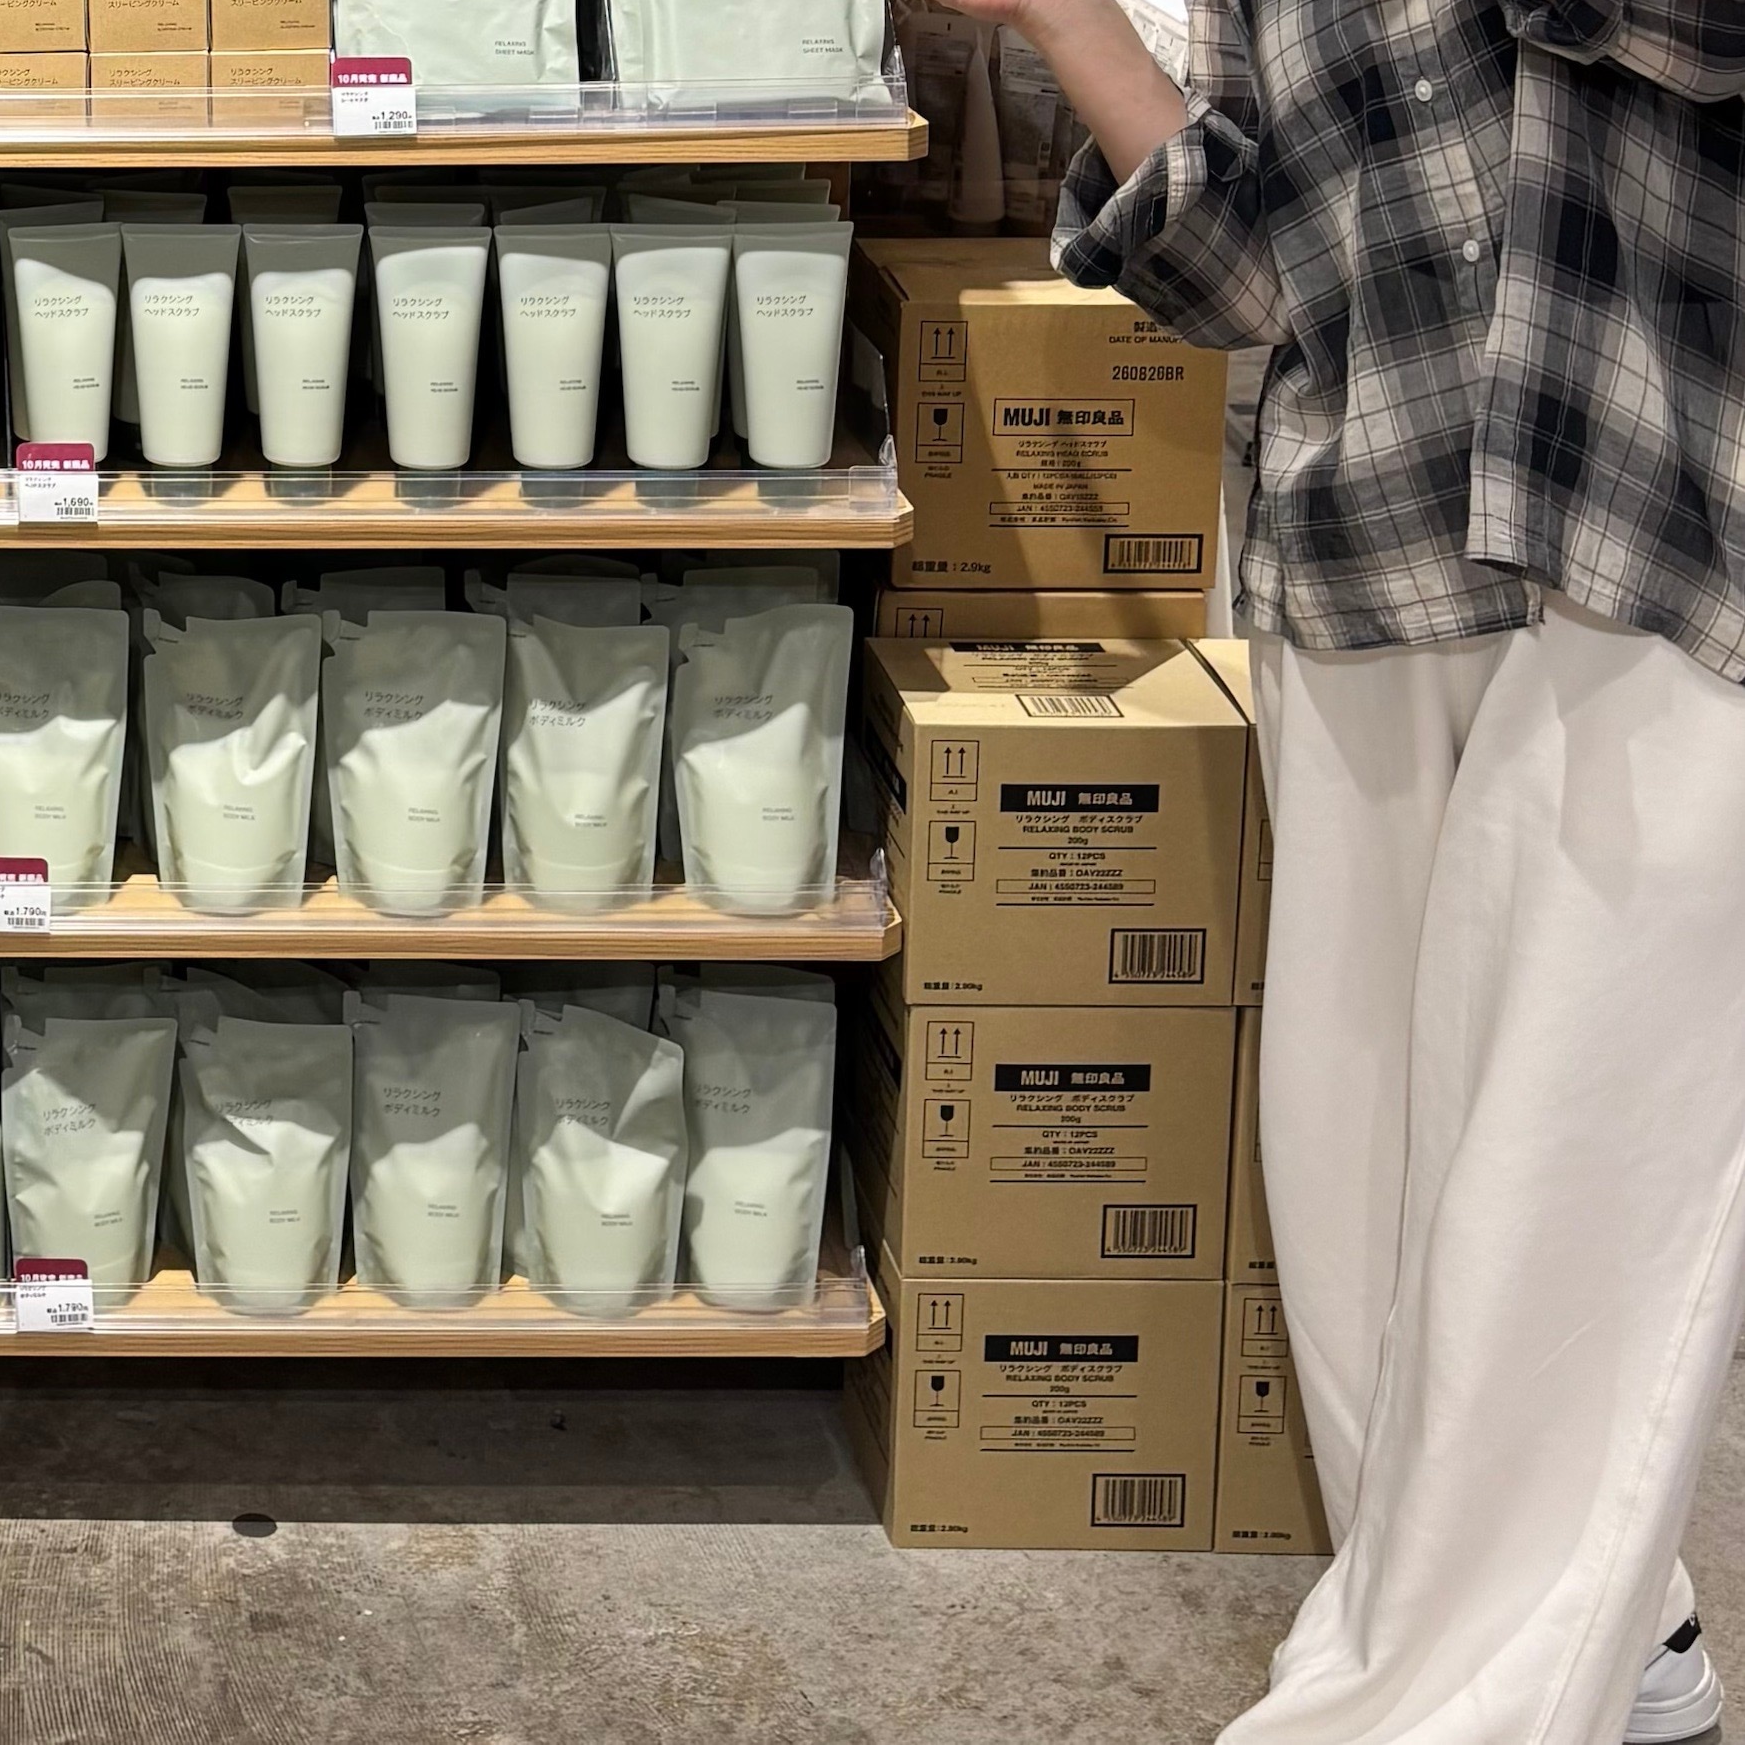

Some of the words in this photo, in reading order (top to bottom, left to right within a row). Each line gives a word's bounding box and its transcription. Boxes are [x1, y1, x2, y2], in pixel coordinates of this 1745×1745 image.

[1004, 408, 1050, 426] MUJI
[1057, 410, 1124, 425] 無印良品
[529, 716, 586, 728] ボディミルク
[1027, 791, 1066, 806] MUJI
[1078, 793, 1133, 805] 無印良品
[1021, 1071, 1059, 1086] MUJI
[1070, 1072, 1125, 1085] 無印良品
[1010, 1341, 1048, 1356] MUJI
[1059, 1343, 1113, 1355] 無印良品
